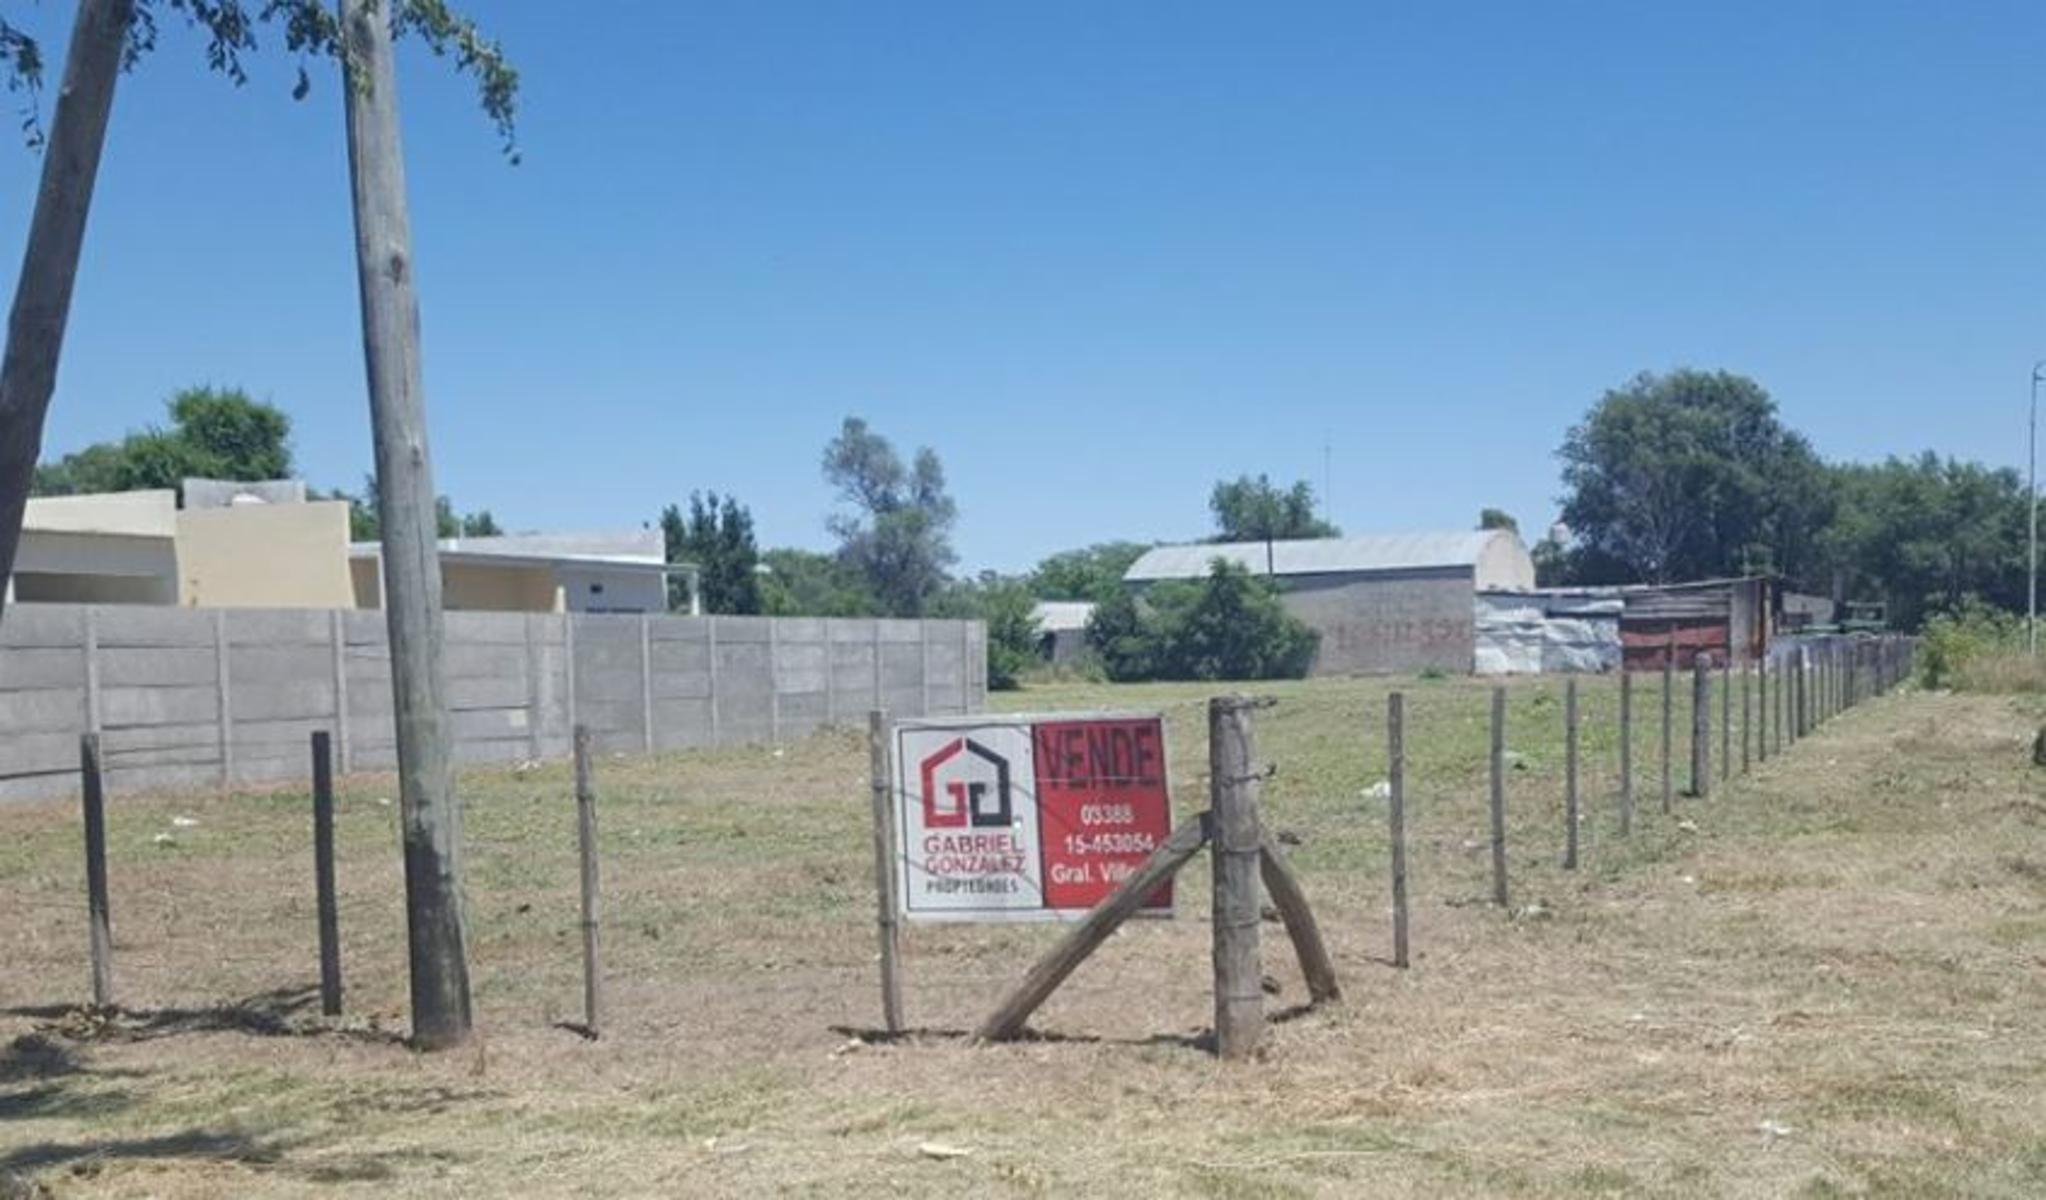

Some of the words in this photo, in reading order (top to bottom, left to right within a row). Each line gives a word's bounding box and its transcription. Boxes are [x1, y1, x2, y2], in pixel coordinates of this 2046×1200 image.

[1039, 727, 1157, 789] VENDE
[924, 833, 1026, 854] GABRIEL
[925, 855, 1026, 875] GONZALEZ
[1051, 862, 1093, 885] Gral.
